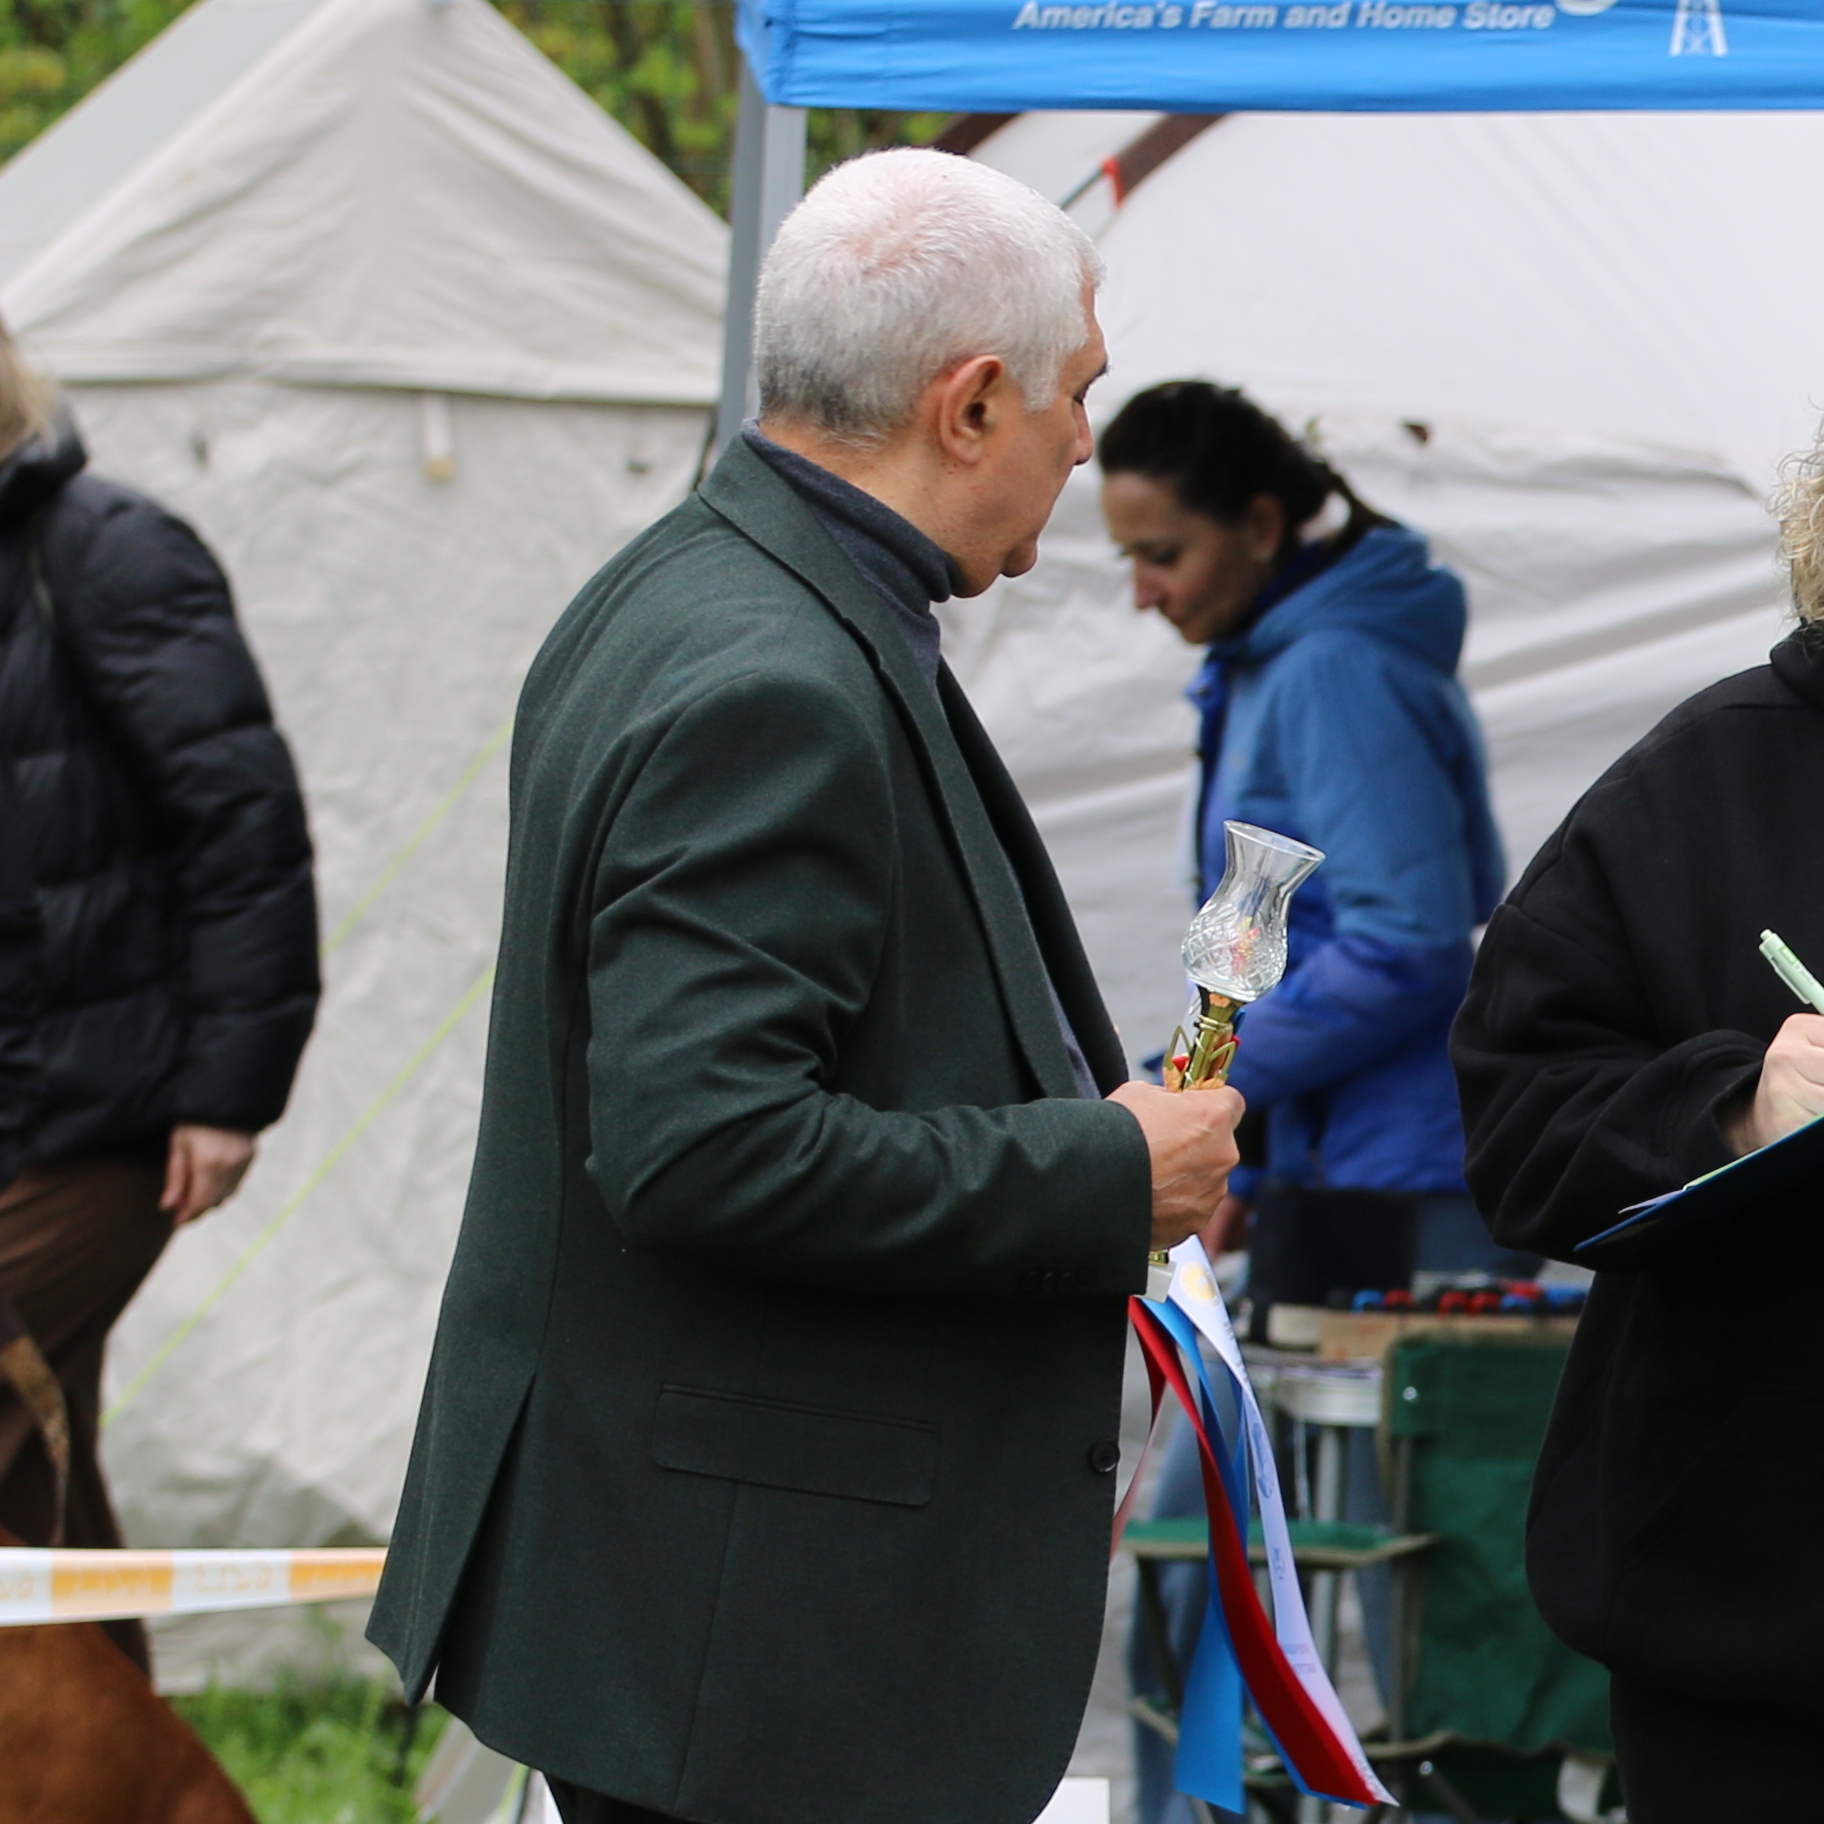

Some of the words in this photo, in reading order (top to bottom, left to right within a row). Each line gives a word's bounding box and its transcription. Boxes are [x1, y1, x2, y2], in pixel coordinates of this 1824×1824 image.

[1011, 0, 1184, 31] America's
[1187, 1, 1279, 30] Farm
[1283, 1, 1351, 30] and
[1355, 2, 1459, 30] Home
[1461, 0, 1557, 31] Store
